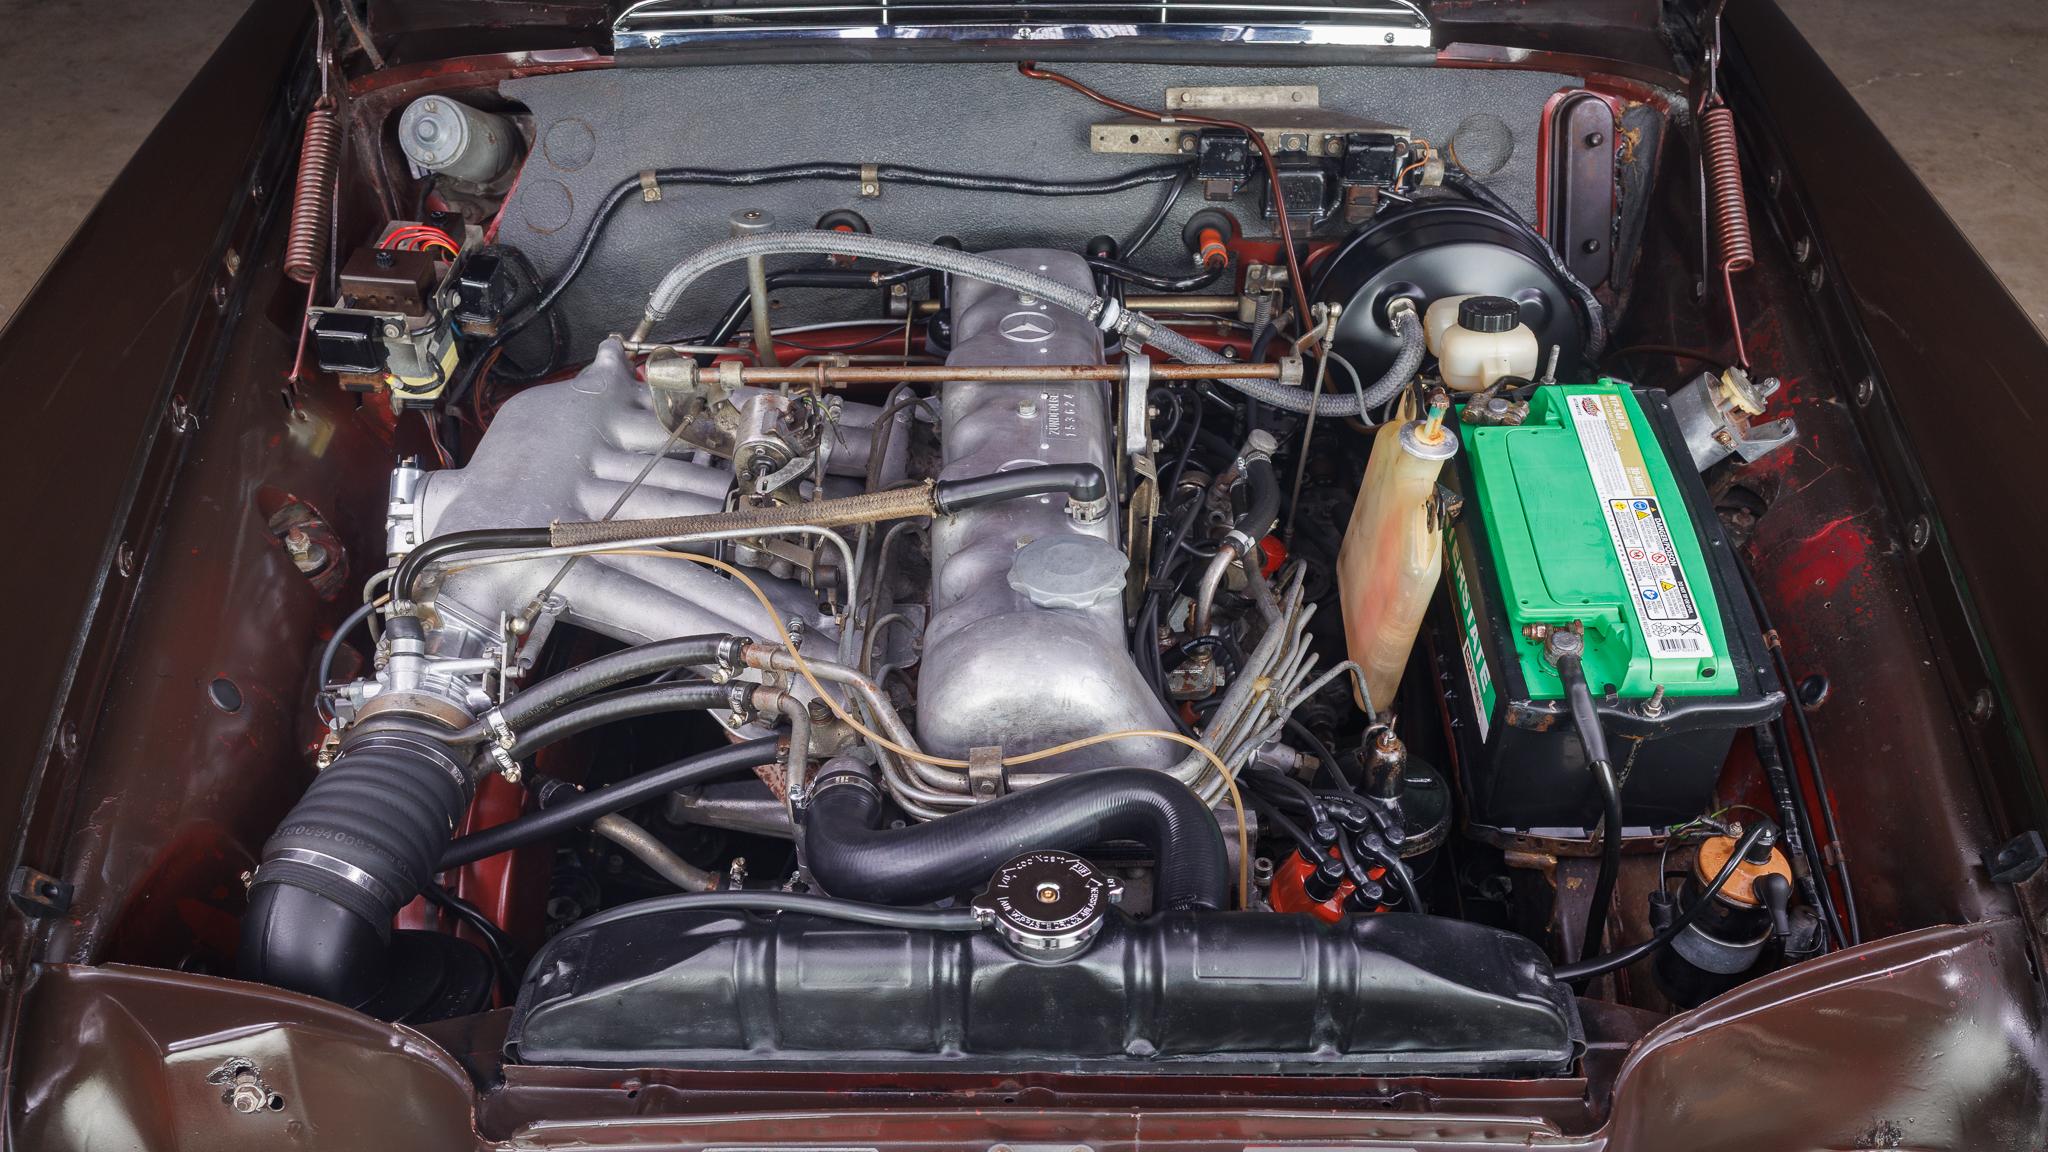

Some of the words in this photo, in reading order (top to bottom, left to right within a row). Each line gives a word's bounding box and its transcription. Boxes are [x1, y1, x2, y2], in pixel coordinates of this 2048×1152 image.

[1654, 517, 1677, 566] DANGER/POISON
[1446, 513, 1490, 693] TERSTATE
[1072, 863, 1089, 876] AUF
